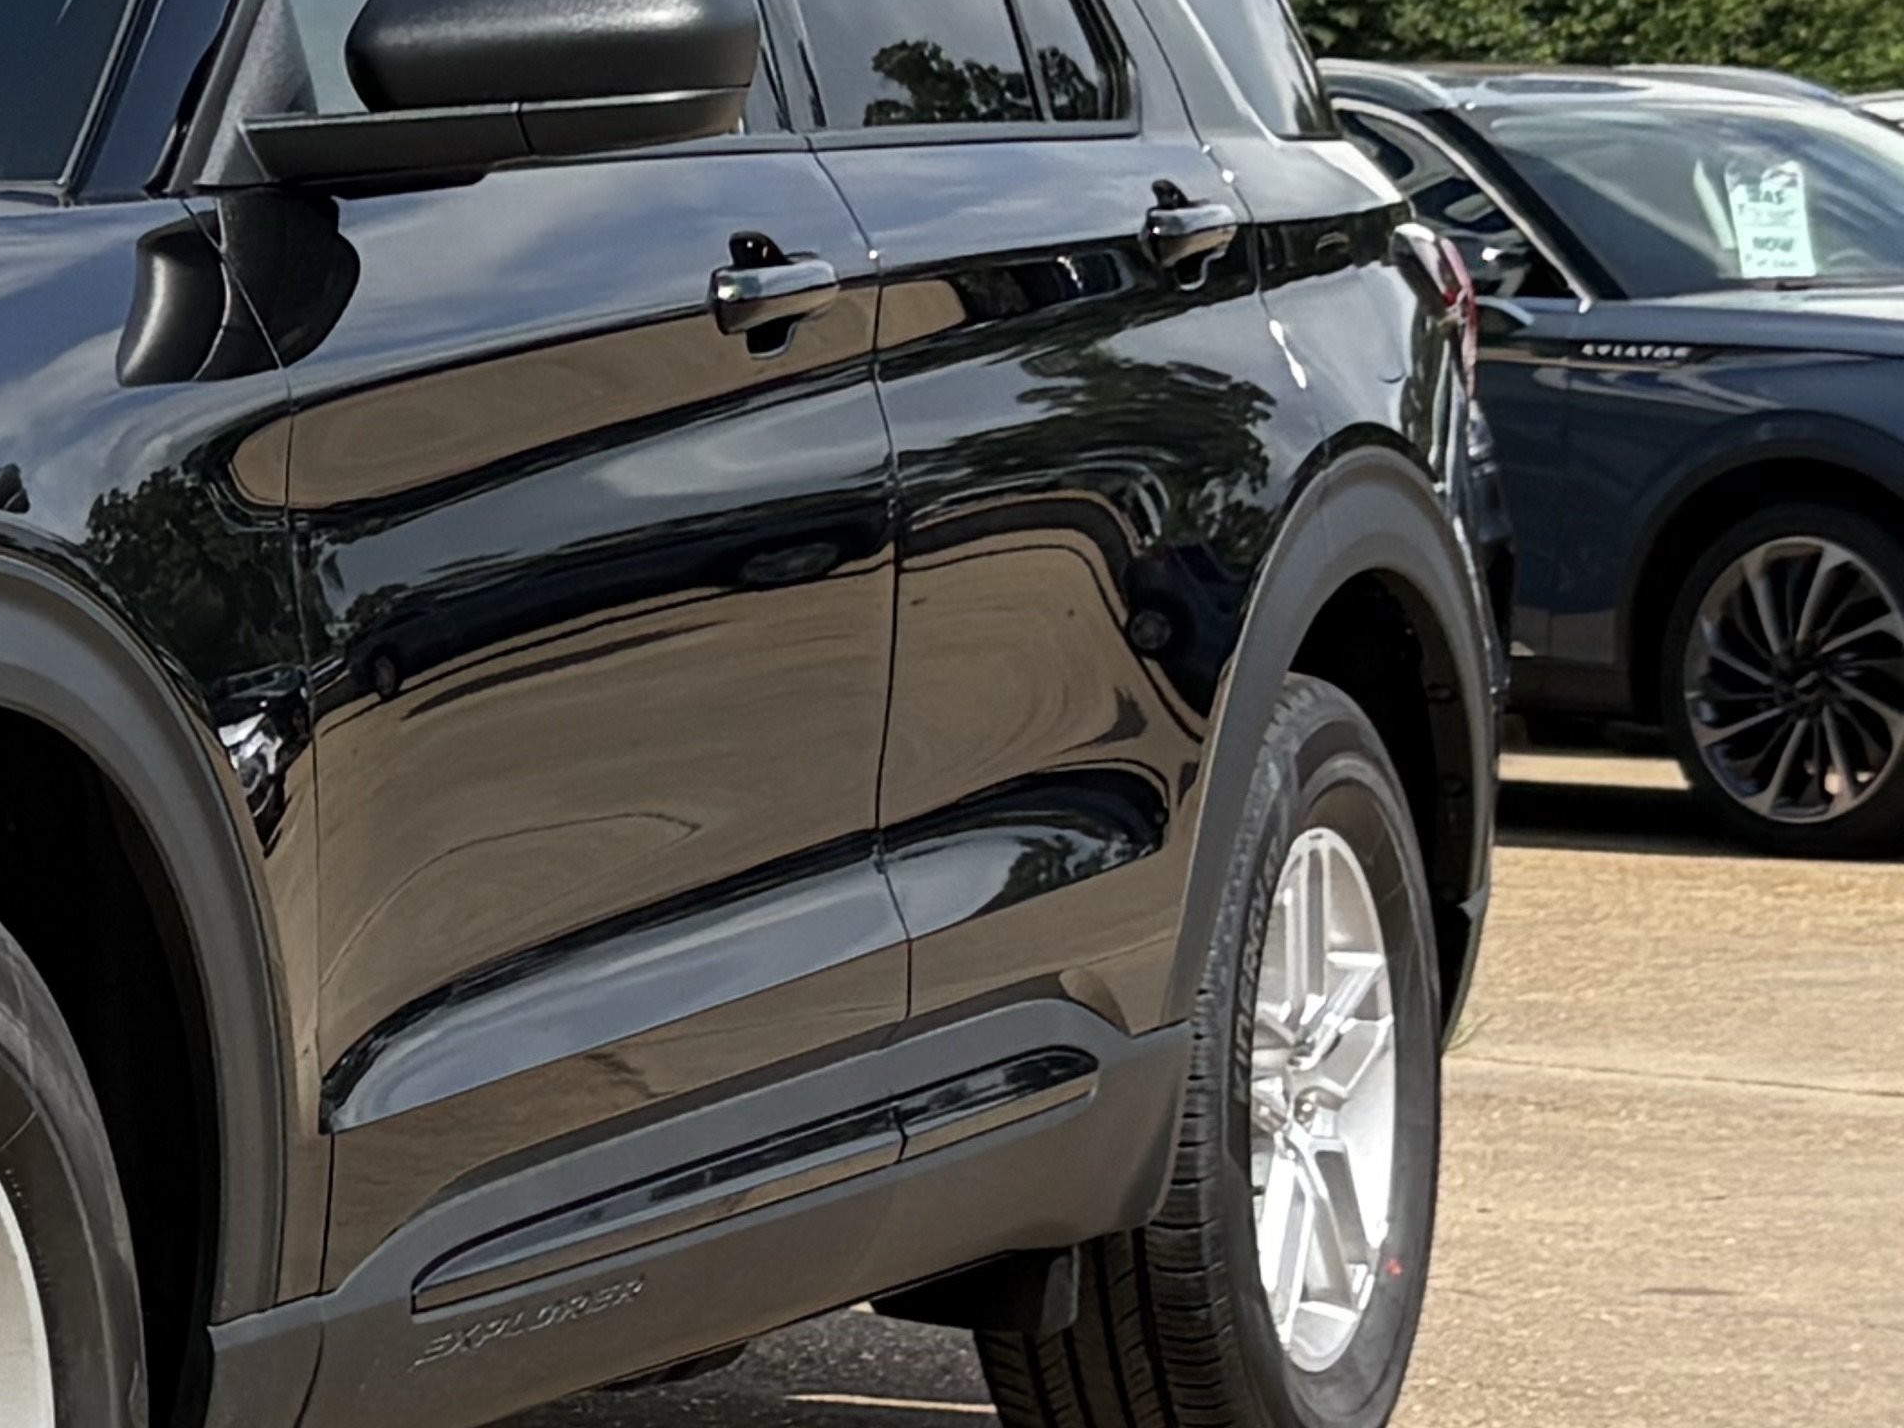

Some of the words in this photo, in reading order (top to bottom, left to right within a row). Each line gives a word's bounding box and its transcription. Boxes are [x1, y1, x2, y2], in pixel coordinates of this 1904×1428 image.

[1751, 235, 1795, 253] NOW
[1580, 342, 1693, 359] AVIATOR
[410, 1273, 647, 1368] EXPLORER
